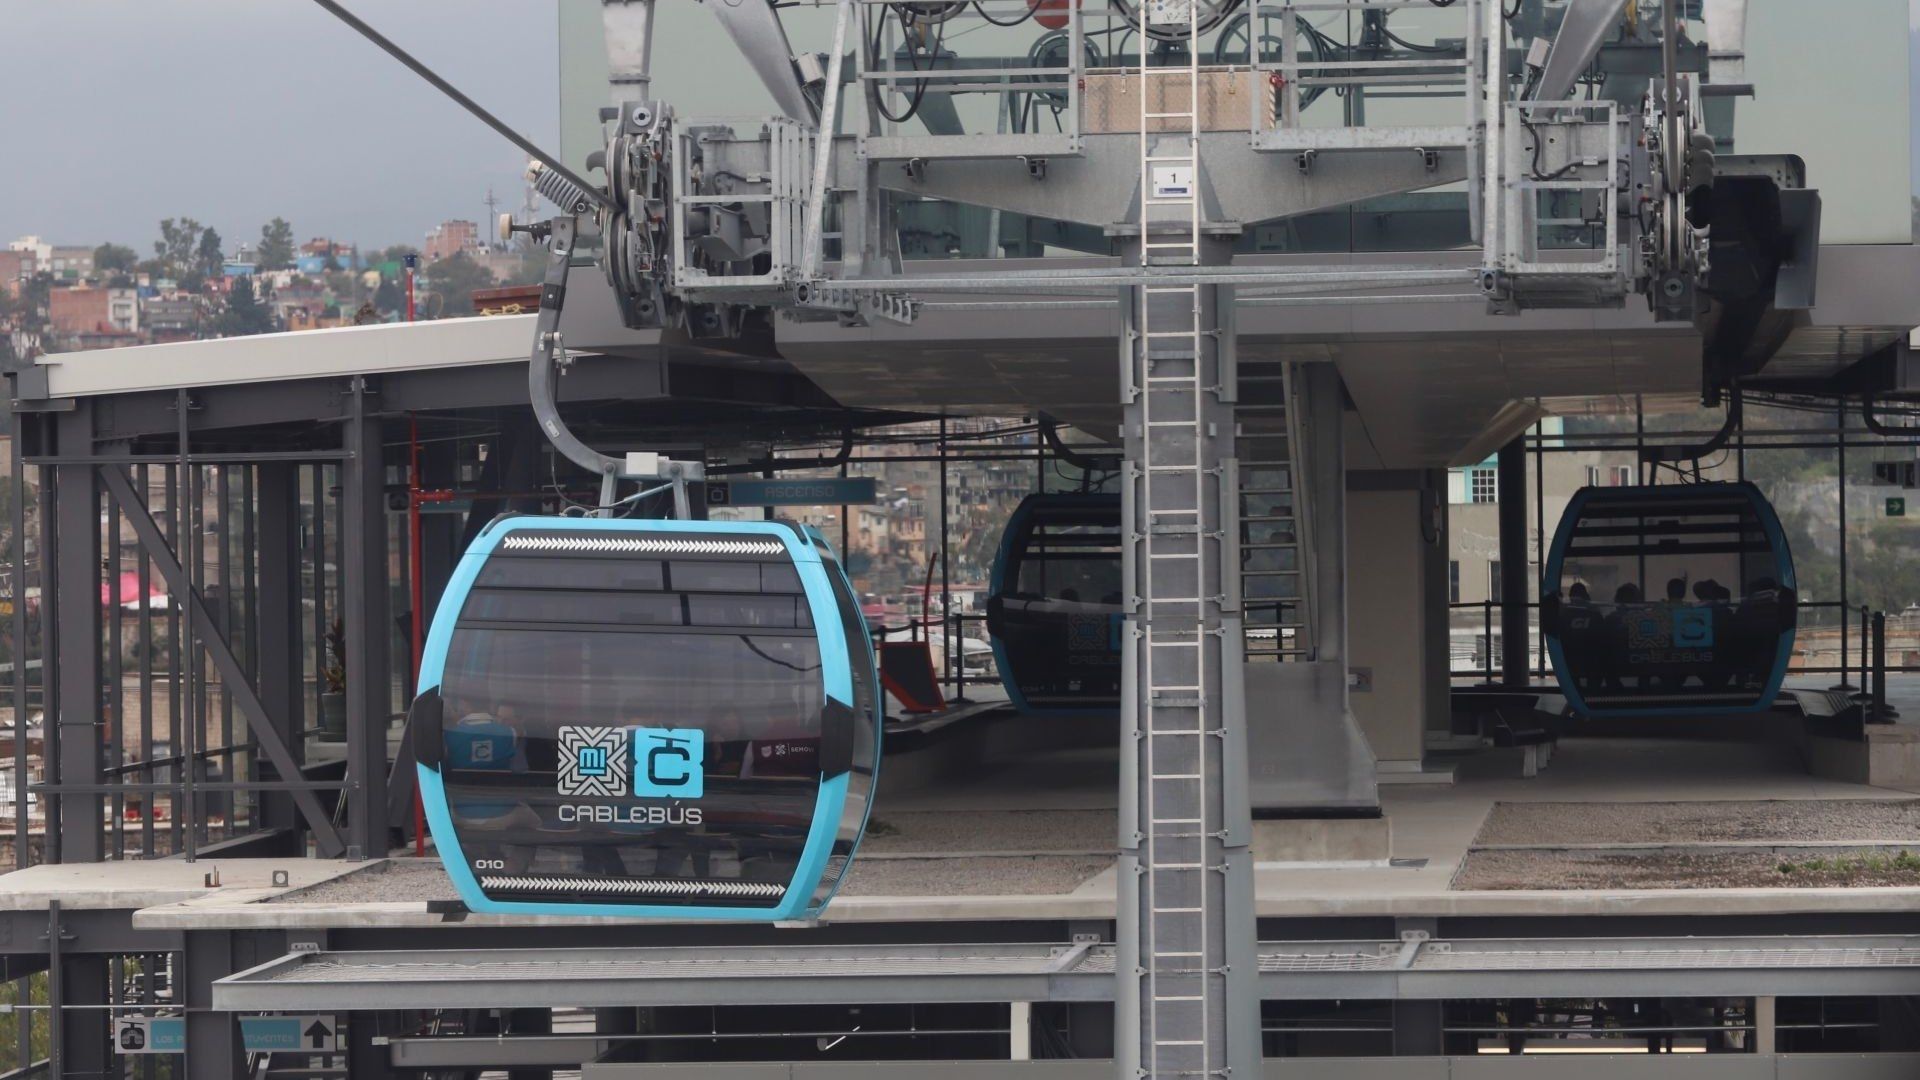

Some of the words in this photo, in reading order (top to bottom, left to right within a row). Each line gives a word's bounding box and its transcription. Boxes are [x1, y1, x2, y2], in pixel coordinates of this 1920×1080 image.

[1170, 173, 1176, 184] 1
[764, 486, 835, 498] ASCENSO
[1069, 655, 1121, 665] CABLE
[558, 801, 702, 825] CABLEBÚS
[475, 859, 504, 869] 010
[155, 1035, 174, 1044] LOS
